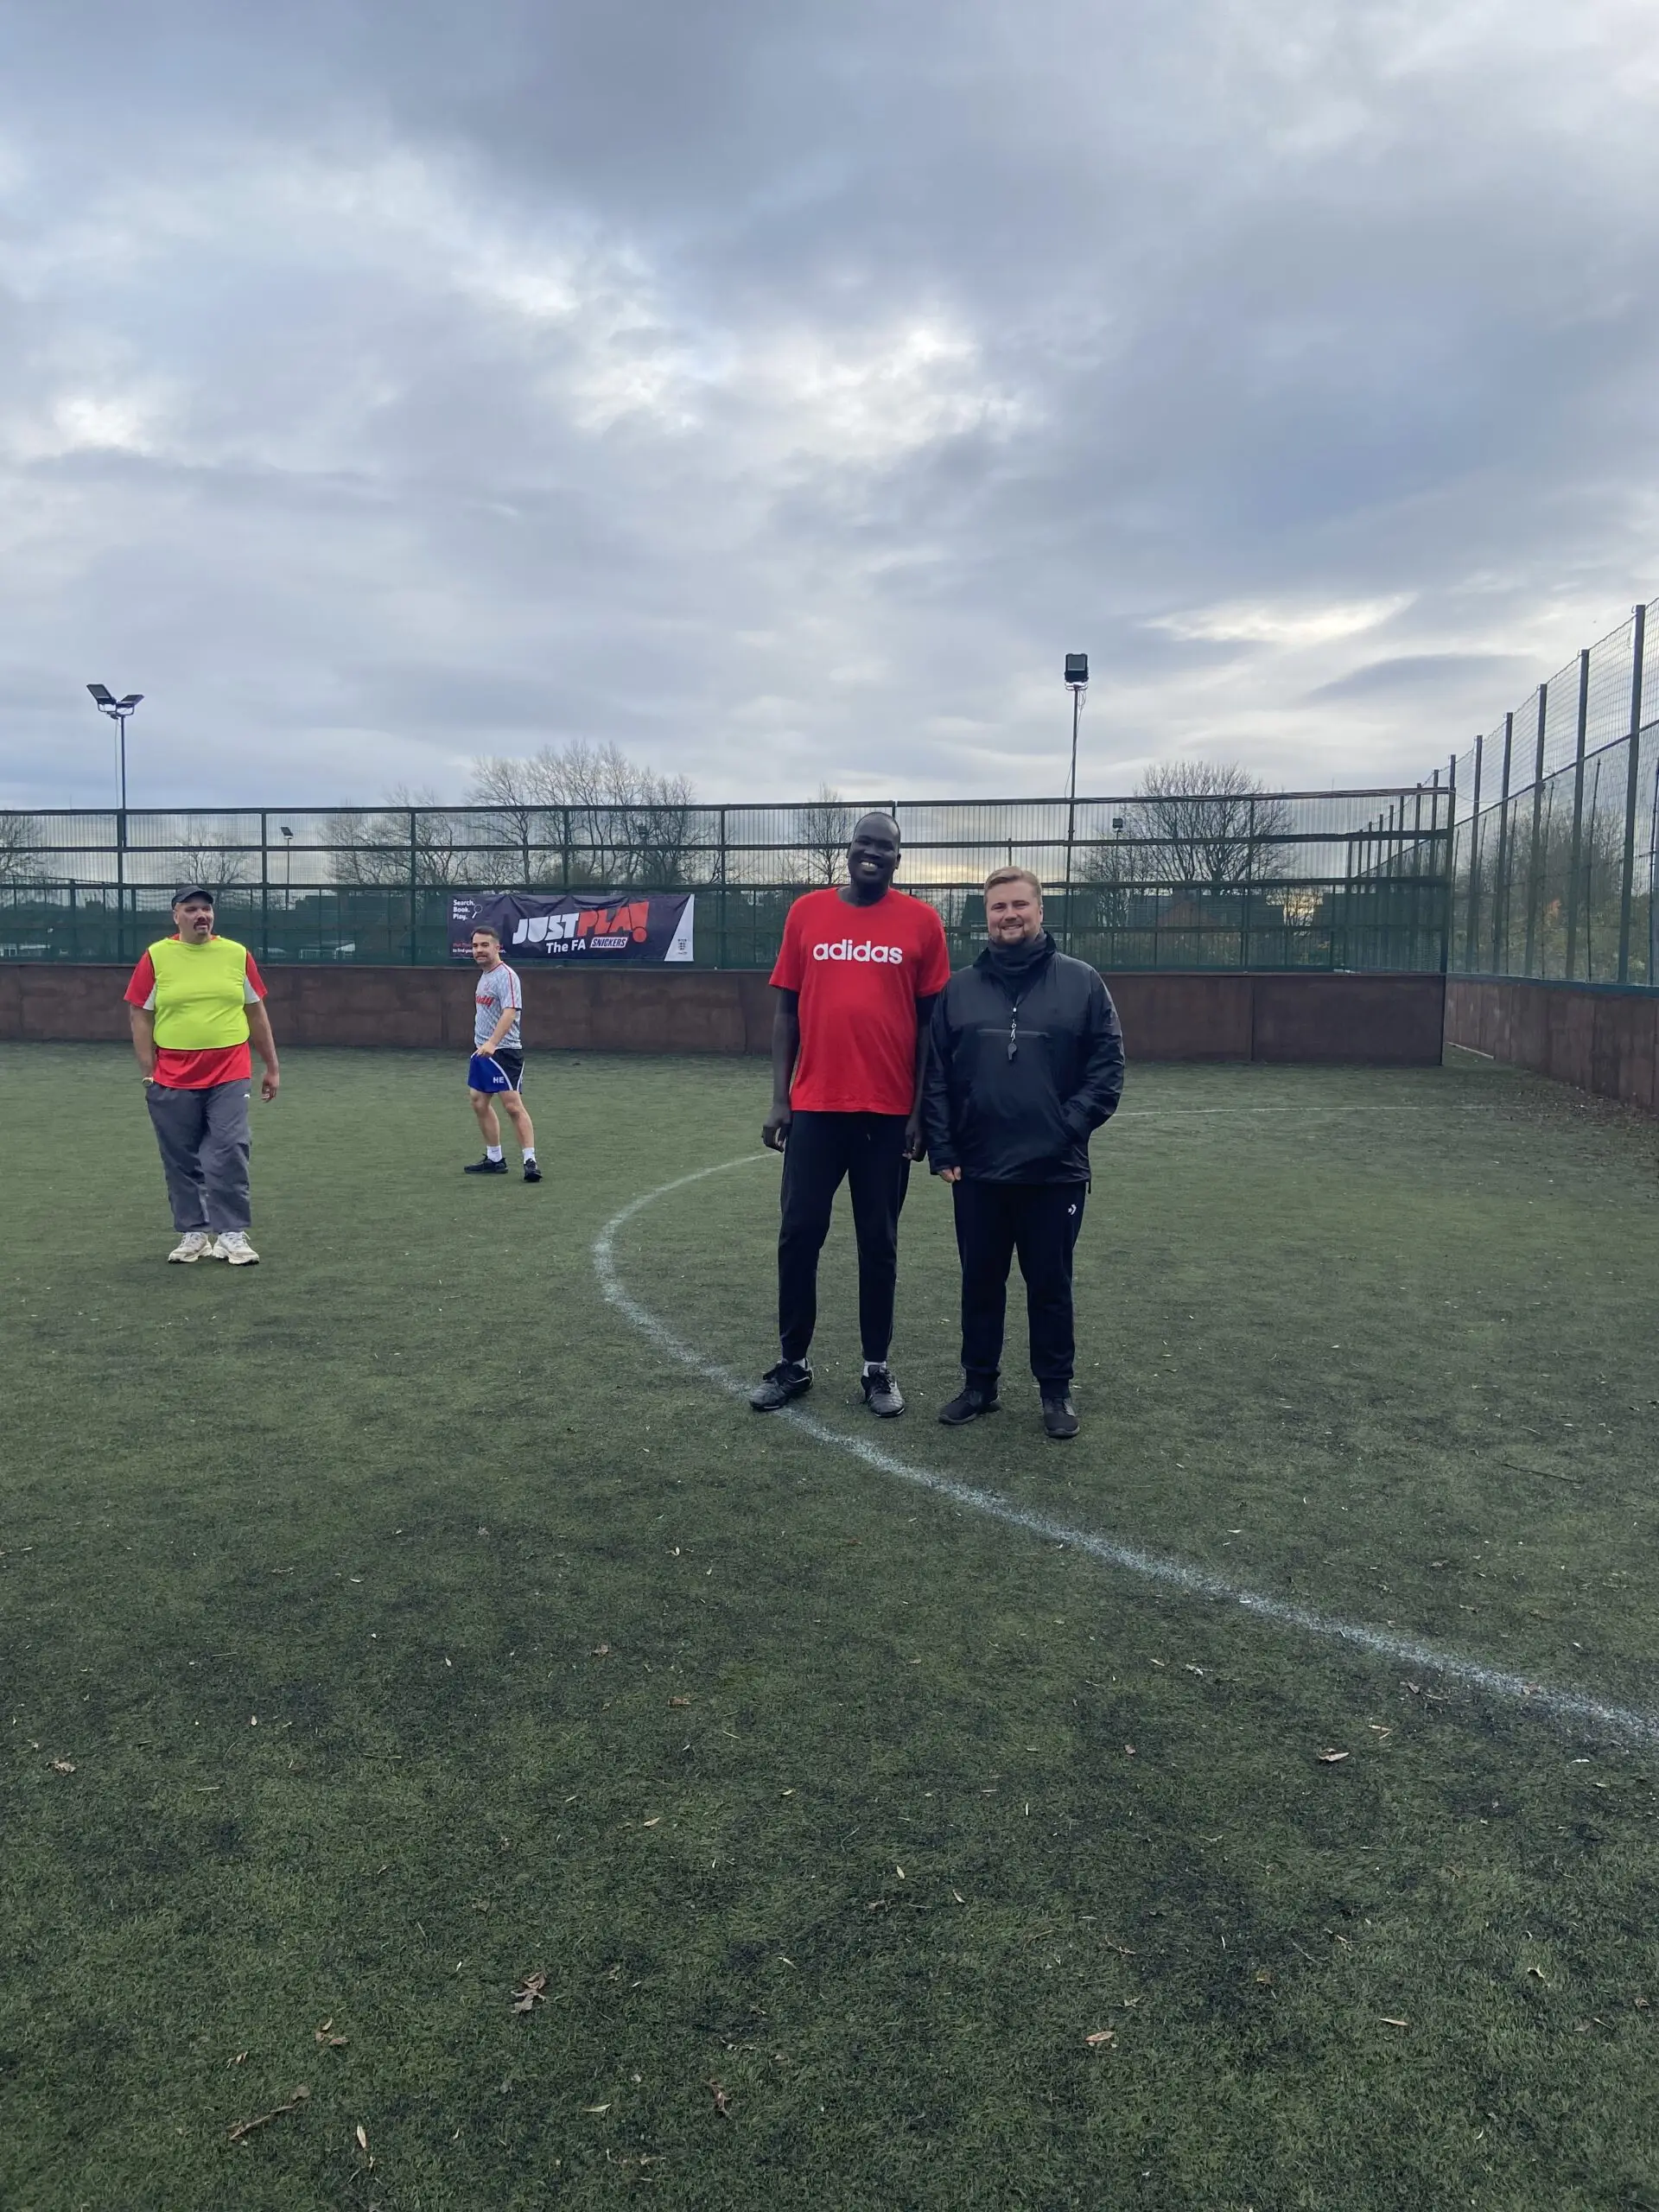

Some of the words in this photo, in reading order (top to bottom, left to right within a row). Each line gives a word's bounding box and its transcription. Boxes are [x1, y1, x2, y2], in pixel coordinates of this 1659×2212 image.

[512, 912, 579, 944] JUST
[546, 941, 569, 954] The
[571, 939, 586, 951] FA
[592, 938, 626, 949] SNICKERS
[812, 939, 902, 964] adidas
